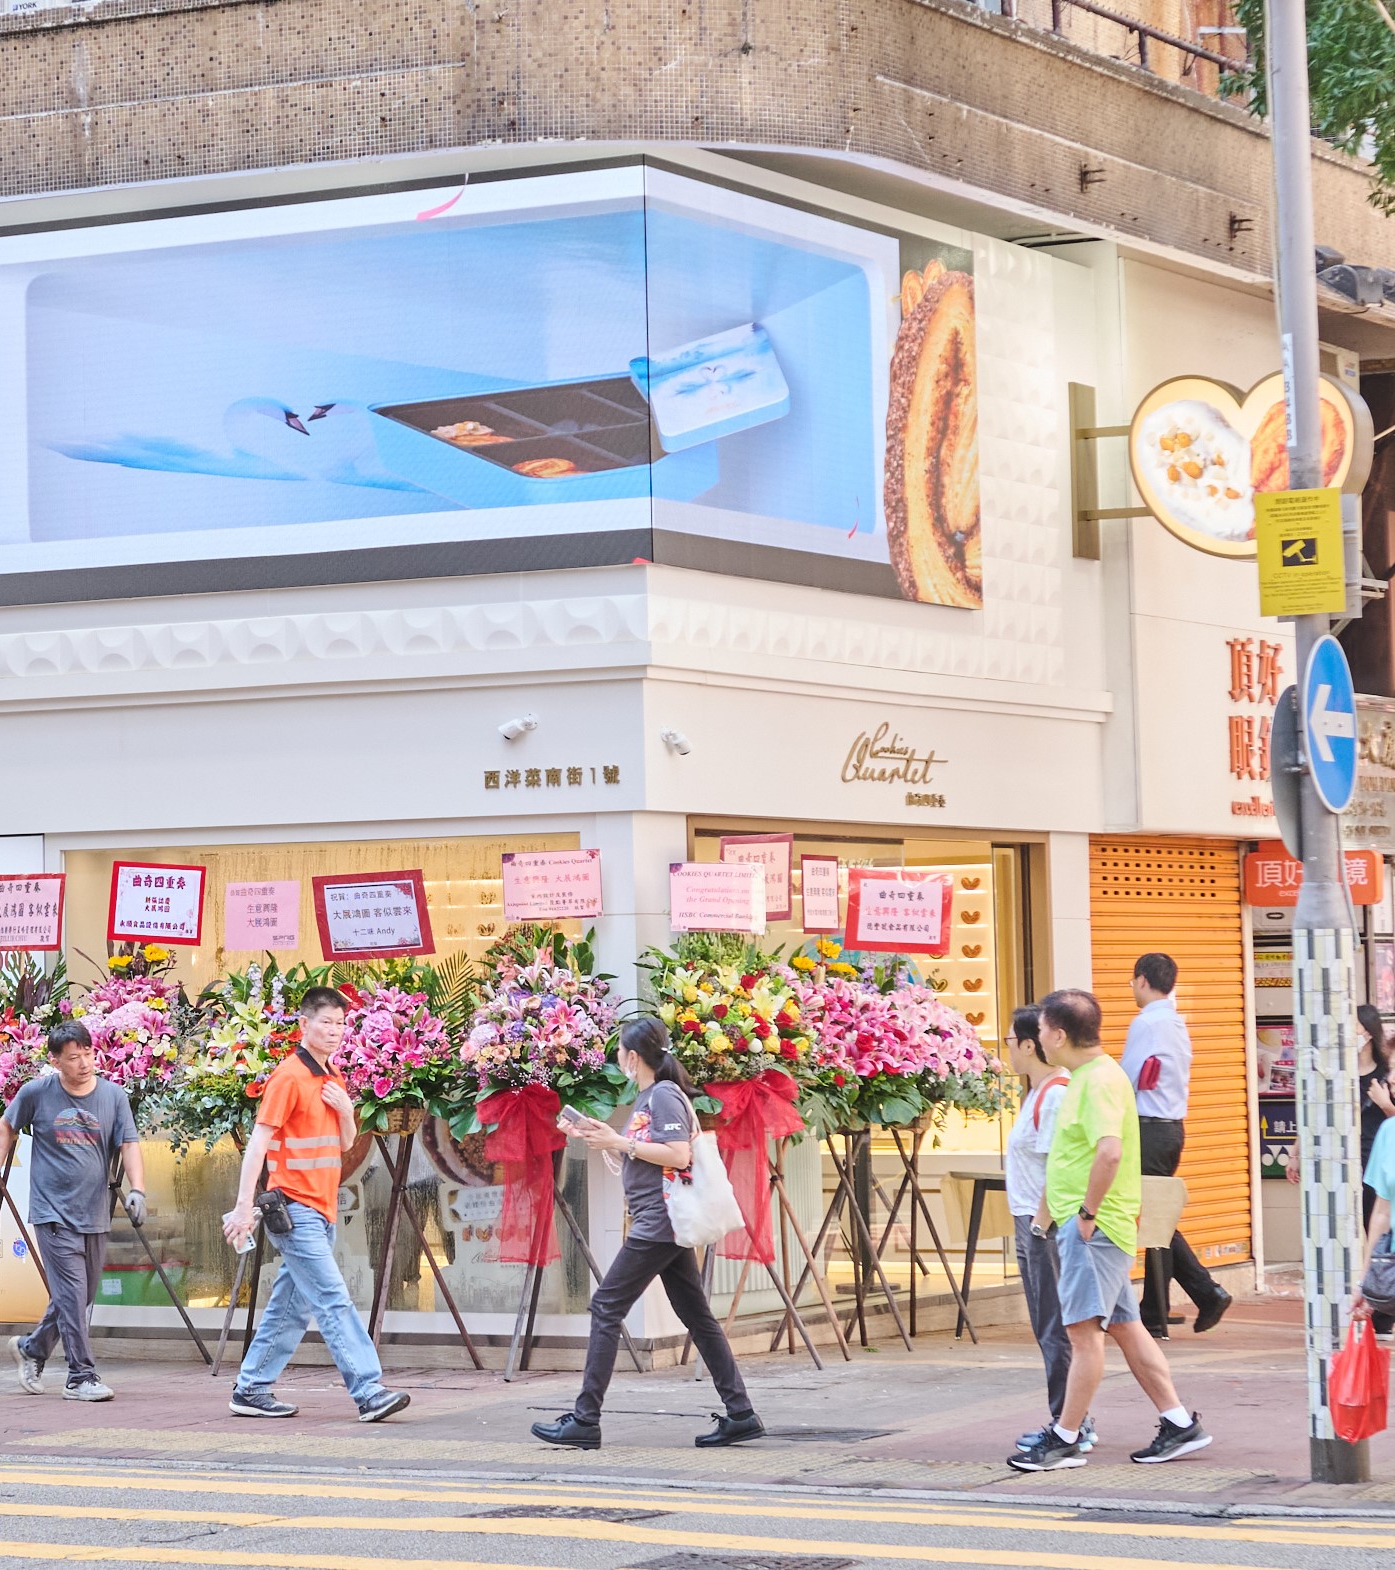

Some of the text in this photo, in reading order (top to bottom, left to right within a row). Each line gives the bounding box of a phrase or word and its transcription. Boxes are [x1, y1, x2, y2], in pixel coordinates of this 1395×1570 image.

[1226, 637, 1284, 704] 頂好
[870, 721, 908, 758] Cookies
[841, 731, 948, 784] Quartet
[1256, 858, 1367, 887] 頂好鏡
[133, 875, 186, 890] 曲奇四重奏
[879, 891, 924, 901] 曲奇四重奏
[333, 906, 412, 920] 大展鴻圖 客似雲來
[377, 927, 395, 935] Andy
[664, 1123, 681, 1131] KFC
